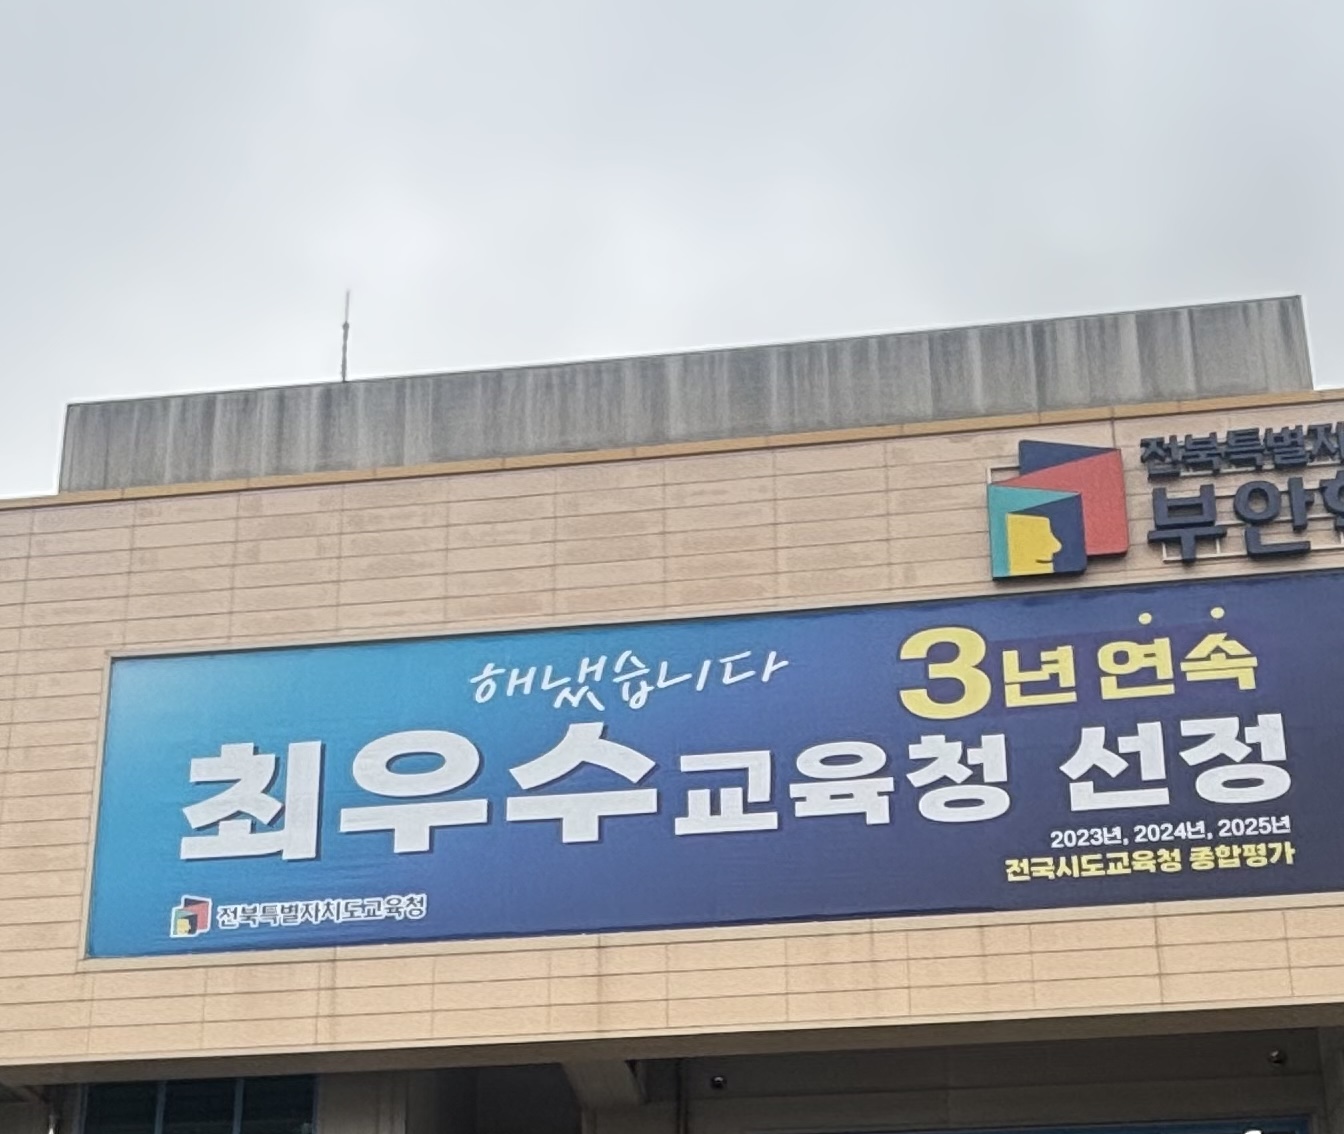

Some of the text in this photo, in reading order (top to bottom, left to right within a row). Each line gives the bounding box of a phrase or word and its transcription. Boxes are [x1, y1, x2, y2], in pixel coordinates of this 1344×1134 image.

[470, 650, 789, 711] 해냈습니다
[898, 626, 1259, 721] 3년 연속
[1059, 713, 1292, 811] 선정
[1050, 814, 1292, 849] 2023년, 2024년, 2025년
[1005, 841, 1296, 882] 전국시도교육청 종합평가
[217, 894, 427, 930] 전북특별자치도교육청
